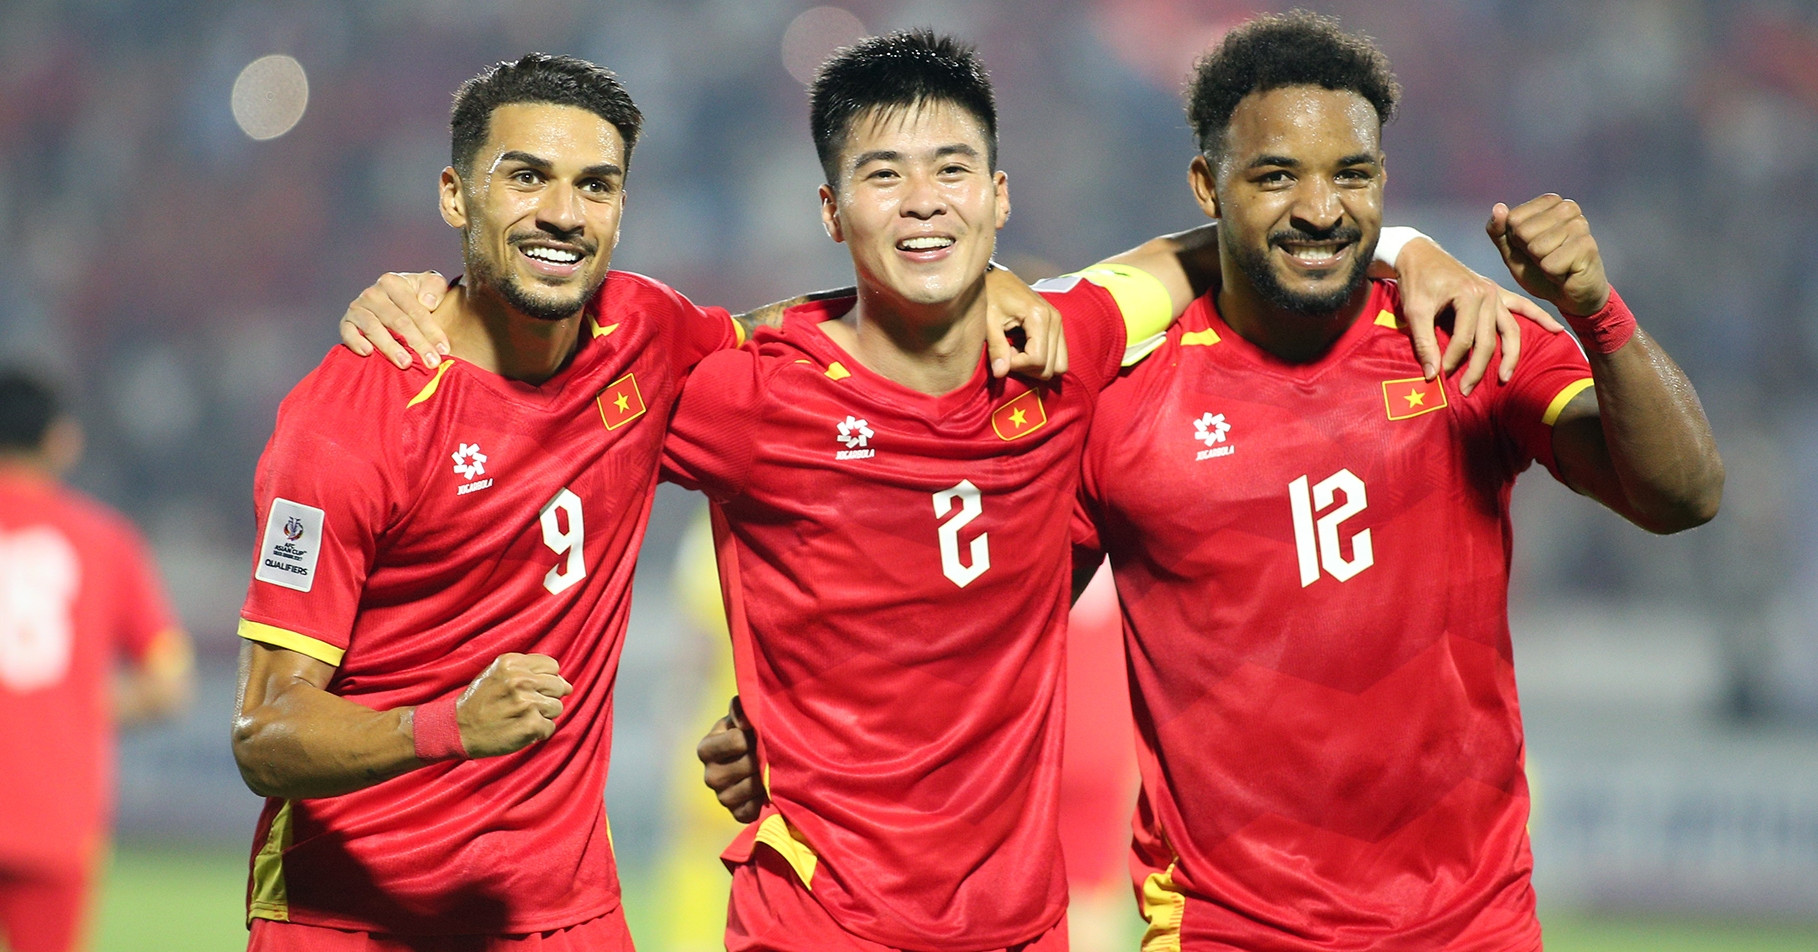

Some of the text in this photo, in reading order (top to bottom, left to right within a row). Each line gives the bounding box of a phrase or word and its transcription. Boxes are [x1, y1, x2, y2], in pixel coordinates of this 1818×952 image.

[265, 559, 308, 575] QUALIFIERS
[274, 545, 291, 553] ASIAN
[538, 486, 587, 596] 9
[931, 478, 991, 588] 2
[1287, 467, 1375, 588] 12
